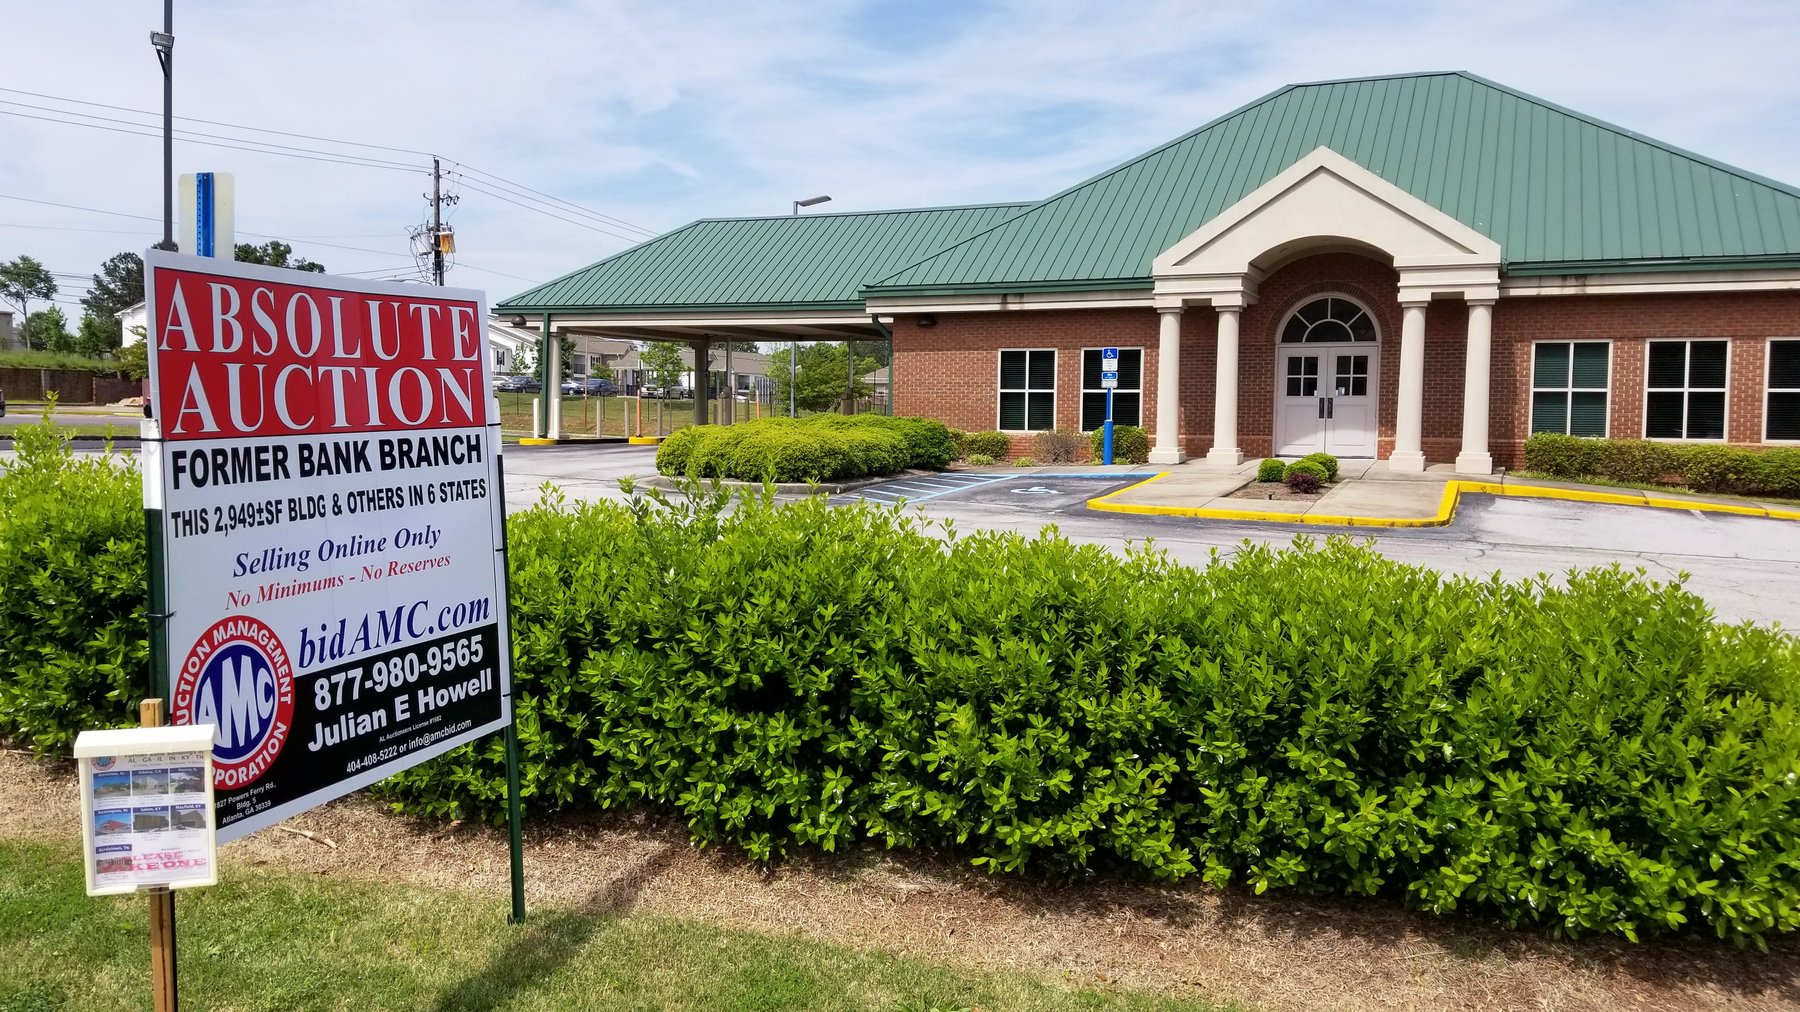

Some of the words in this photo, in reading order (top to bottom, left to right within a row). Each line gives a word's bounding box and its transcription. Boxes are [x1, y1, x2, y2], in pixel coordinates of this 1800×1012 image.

[157, 278, 479, 362] ABSOLUTE
[171, 361, 474, 434] AUCTION
[171, 444, 291, 490] FORMER
[298, 440, 372, 478] BANK
[378, 433, 482, 471] BRANCH
[171, 511, 209, 538] THIS
[288, 494, 326, 521] BLDG
[332, 496, 343, 516] &
[347, 487, 404, 514] OTHERS
[409, 484, 424, 507] IN
[428, 483, 435, 504] 6
[439, 478, 486, 503] STATES
[233, 547, 311, 578] Selling
[317, 534, 387, 562] Online
[394, 524, 441, 549] Only
[225, 591, 251, 611] No
[256, 575, 344, 603] Minimums
[361, 565, 383, 583] No
[387, 555, 451, 578] Reserves
[298, 597, 490, 669] bidAMC.com
[177, 640, 211, 726] UCTION
[213, 620, 291, 704] MANAGEMENT
[198, 655, 273, 748] AMC
[314, 634, 484, 711] 877-980-9565
[308, 708, 387, 752] Julian
[394, 694, 410, 722] E
[418, 668, 492, 714] Howell
[386, 727, 412, 740] Auctioneers
[412, 720, 429, 731] License
[212, 721, 287, 786] PORATION
[346, 745, 398, 773] 404-408-5222
[399, 743, 408, 753] or
[408, 719, 472, 746] info@amcbid.com
[228, 792, 249, 804] Powers
[250, 786, 265, 796] Ferry
[236, 800, 251, 810] Bldg.
[245, 806, 254, 816] GA
